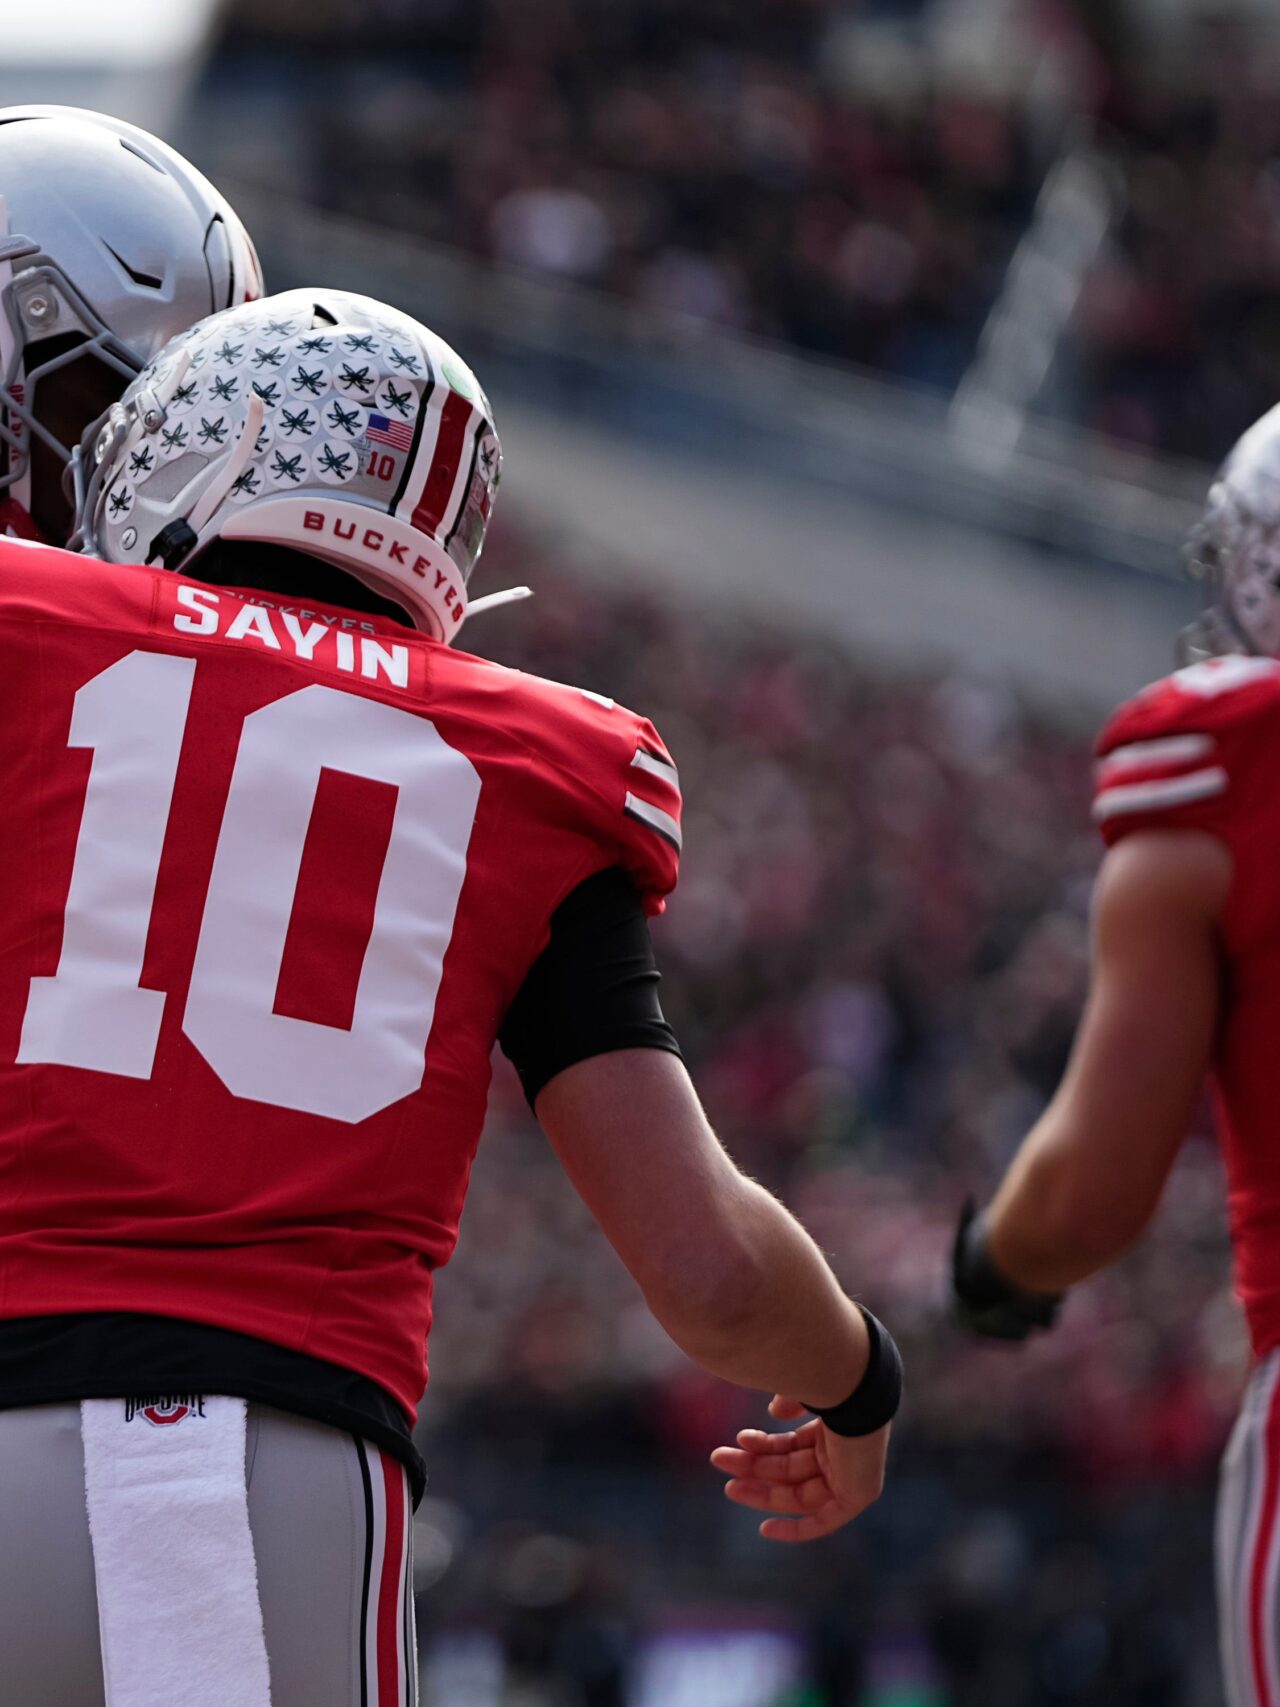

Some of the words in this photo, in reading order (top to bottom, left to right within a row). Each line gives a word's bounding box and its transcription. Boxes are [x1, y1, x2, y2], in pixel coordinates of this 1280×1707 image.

[366, 450, 396, 481] 10
[303, 510, 464, 622] BUCKEYES
[173, 585, 409, 688] SAYIN
[15, 650, 482, 1124] 10
